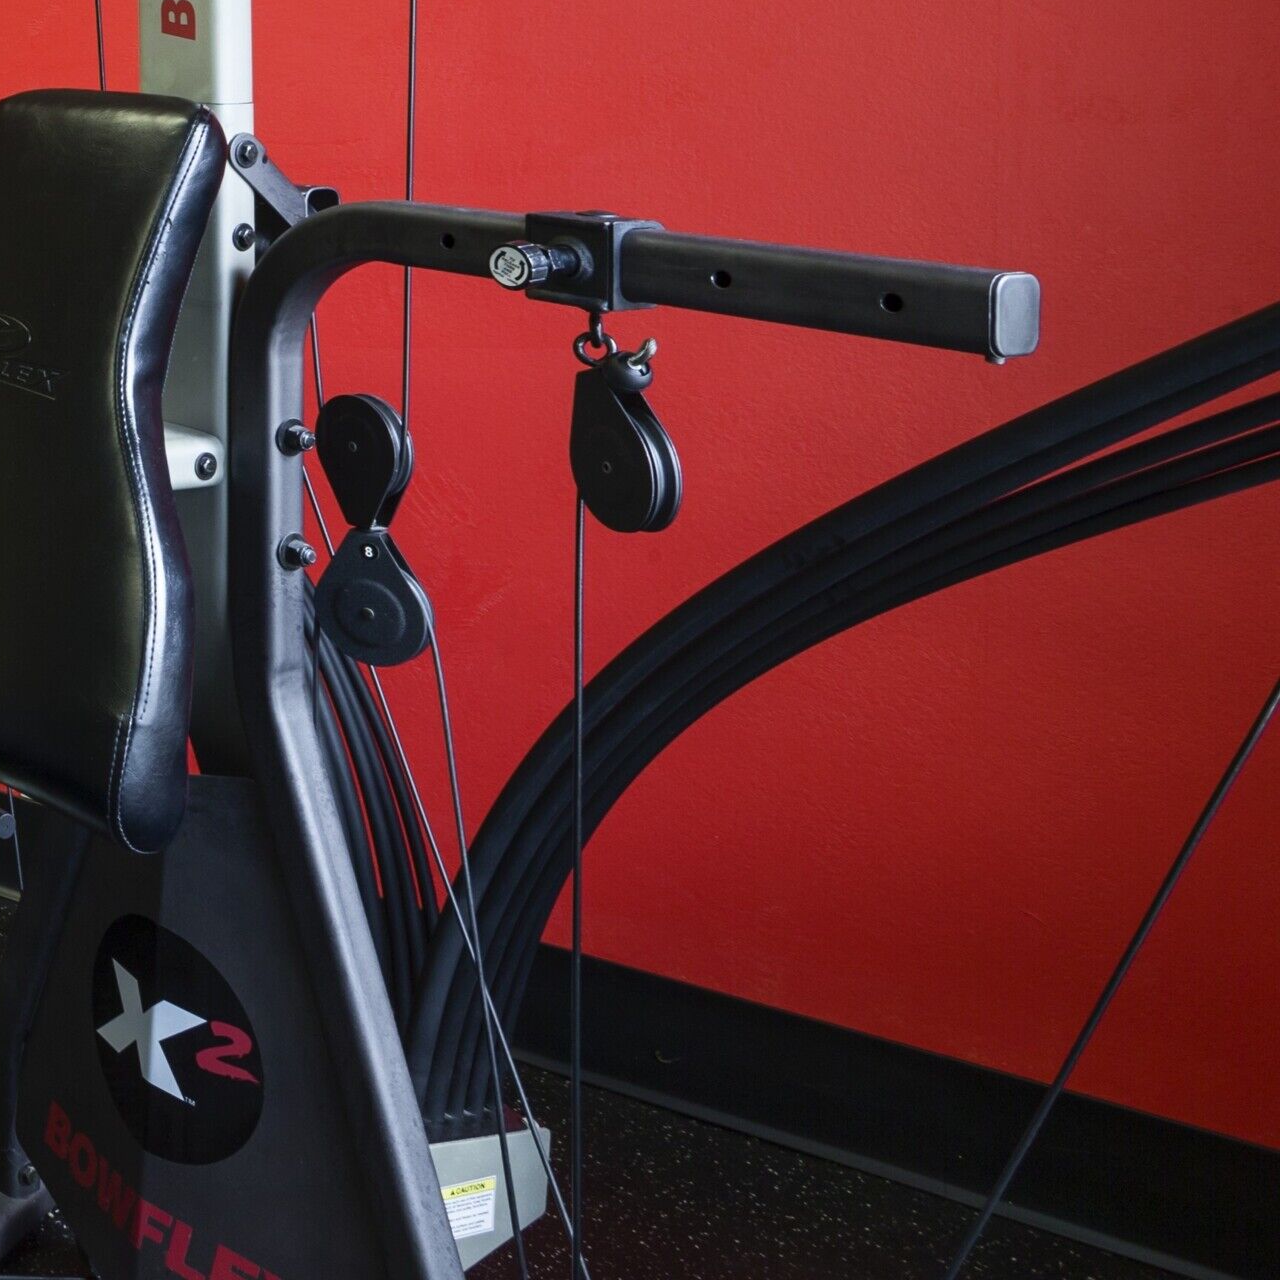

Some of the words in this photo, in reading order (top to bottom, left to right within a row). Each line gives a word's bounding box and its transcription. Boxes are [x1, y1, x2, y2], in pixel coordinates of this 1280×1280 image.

[364, 546, 374, 557] 8
[43, 1098, 285, 1280] BOWFLE
[456, 1183, 485, 1195] CAUTION
